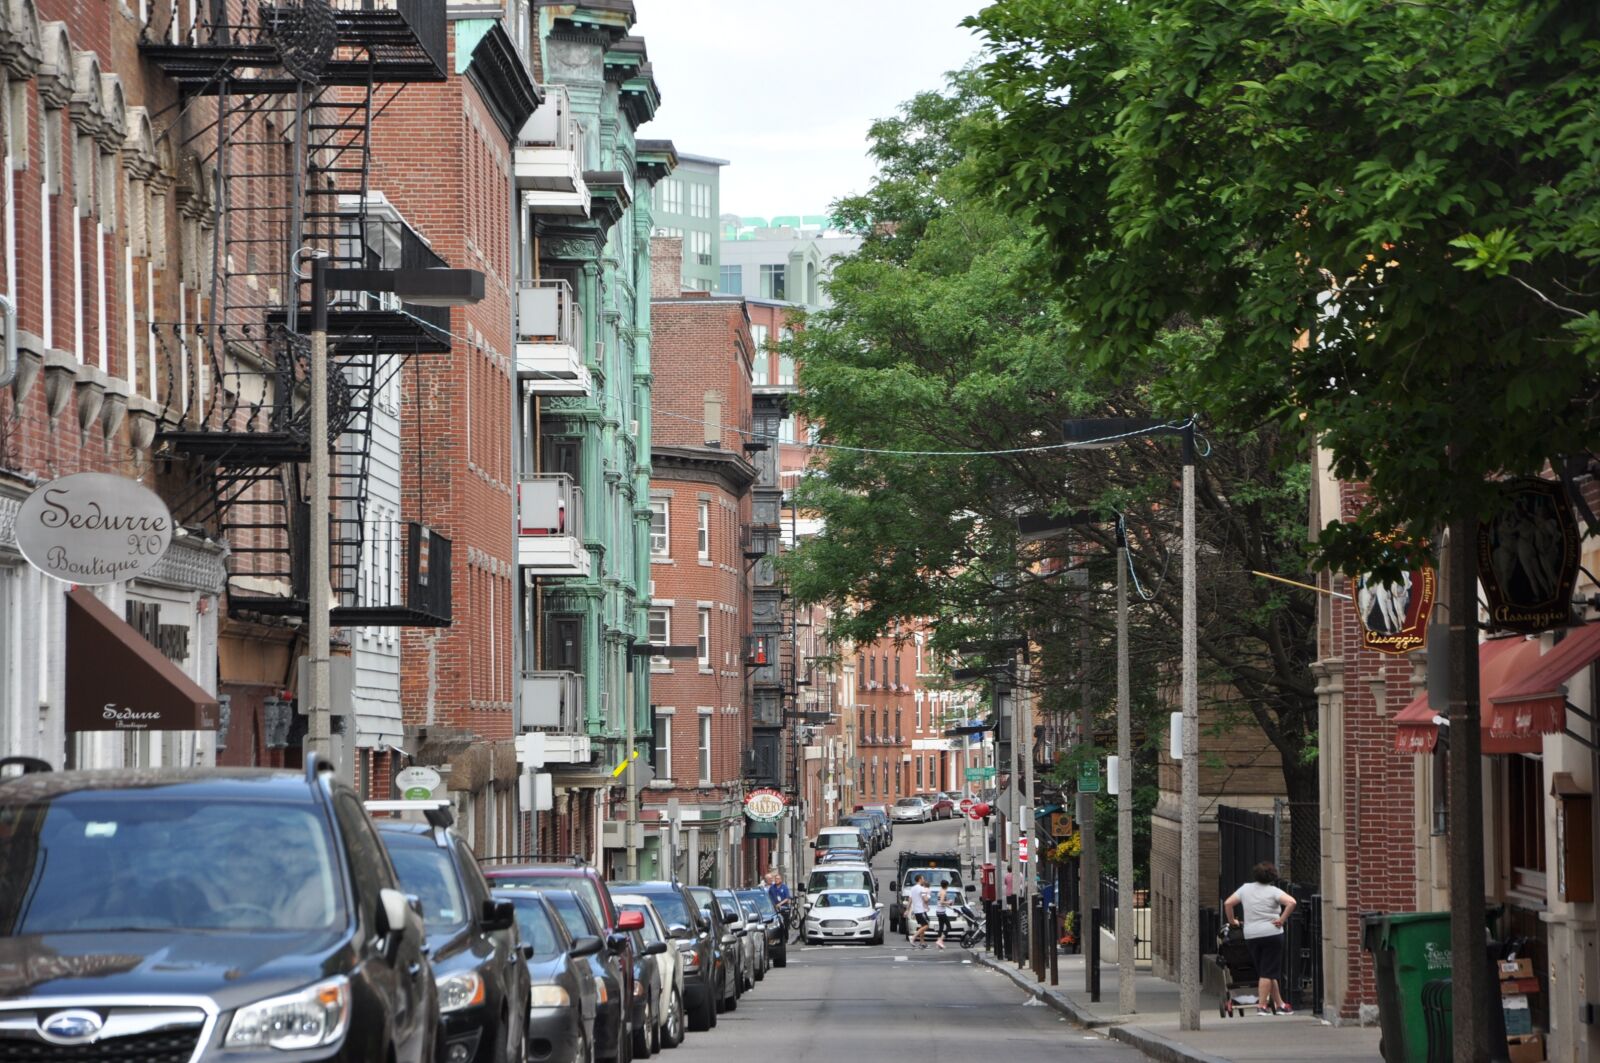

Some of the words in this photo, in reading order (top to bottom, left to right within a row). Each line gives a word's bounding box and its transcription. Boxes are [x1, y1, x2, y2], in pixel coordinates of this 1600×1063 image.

[39, 488, 167, 532] Sedurre
[127, 534, 163, 556] XO
[47, 545, 140, 581] Boutique
[1494, 604, 1566, 627] Assaggio
[1365, 630, 1423, 649] Assaggio
[102, 703, 161, 720] Sedurre
[749, 801, 780, 813] BAKERY
